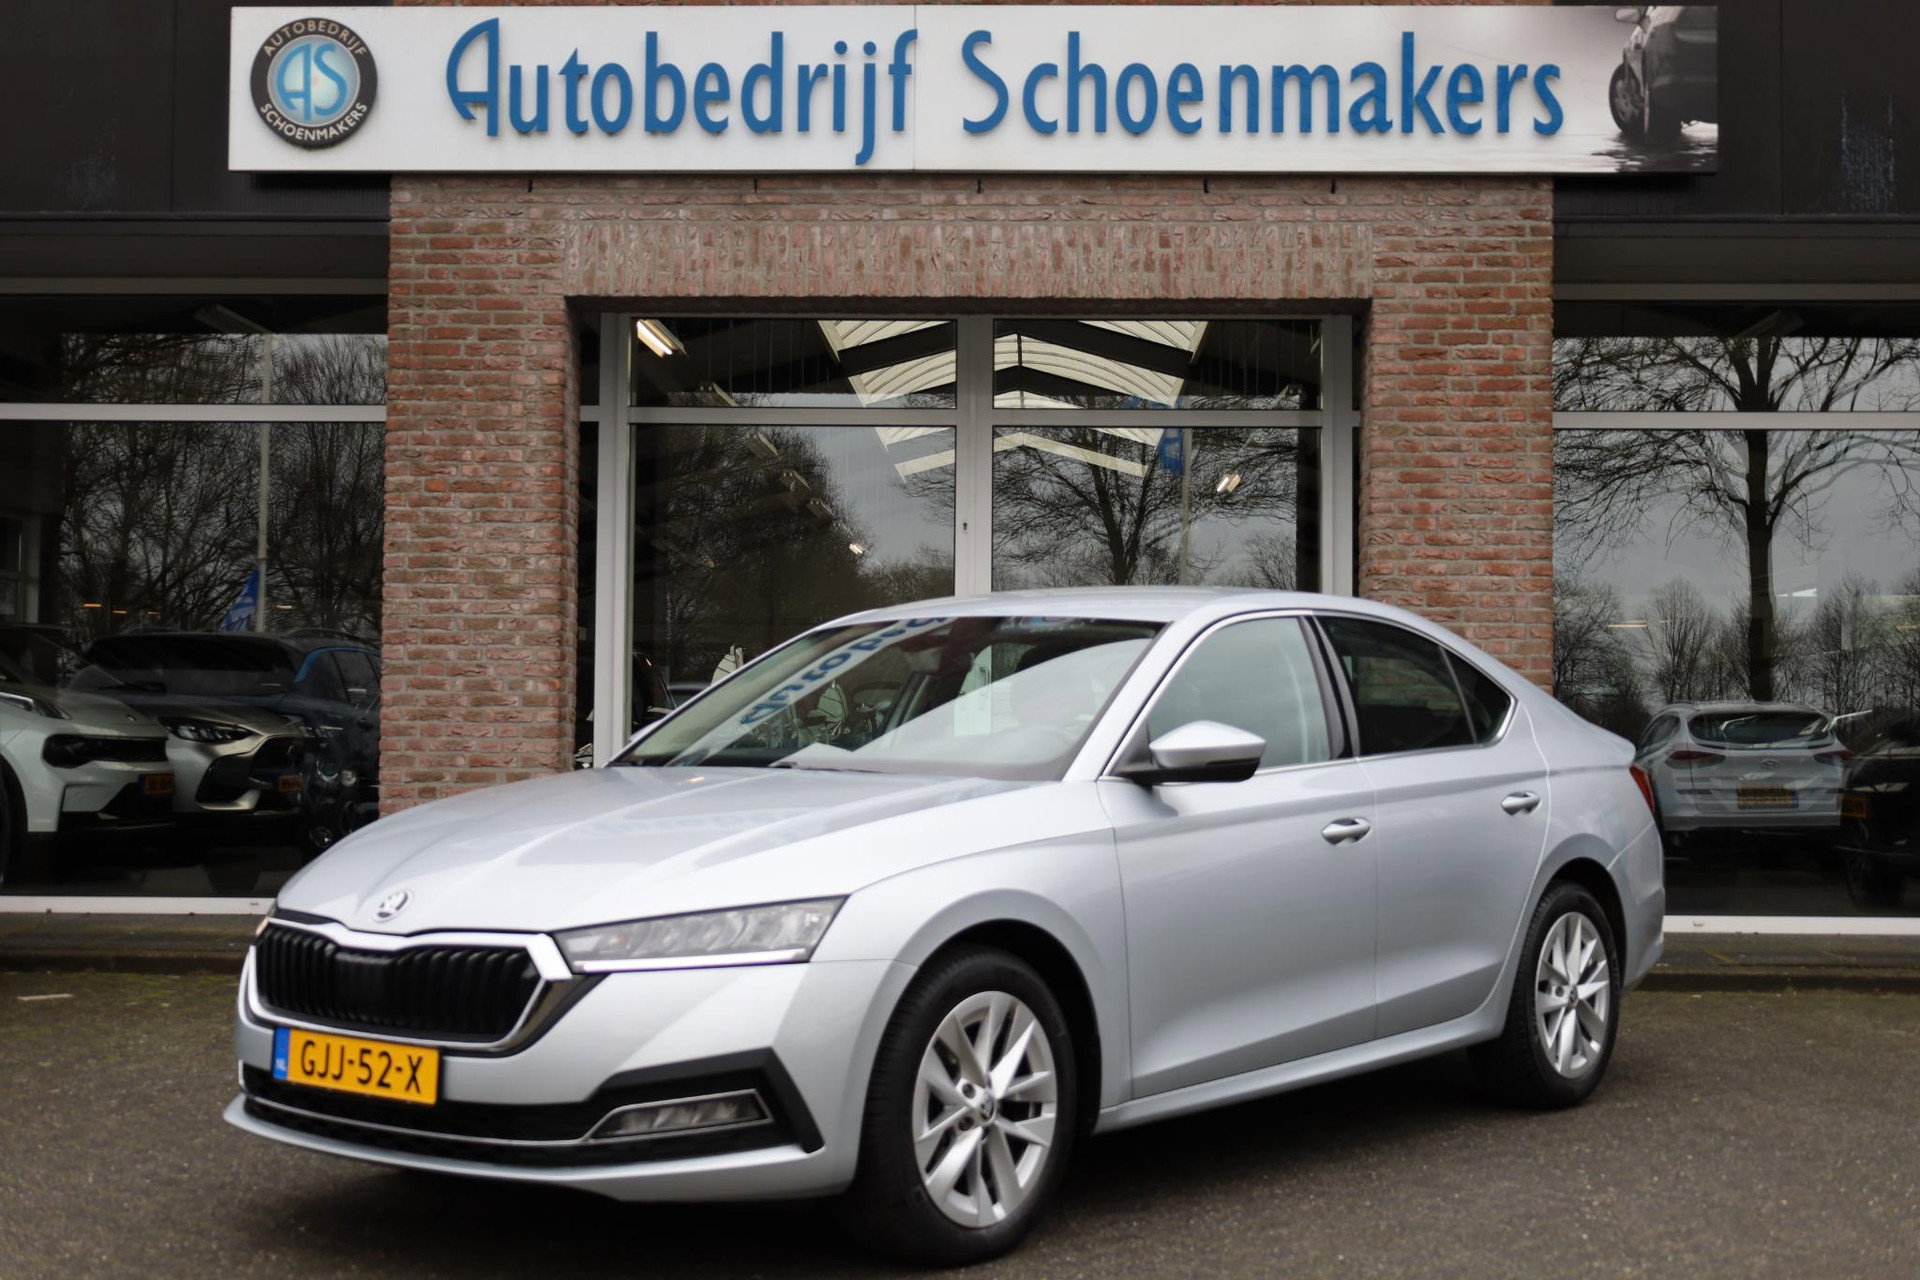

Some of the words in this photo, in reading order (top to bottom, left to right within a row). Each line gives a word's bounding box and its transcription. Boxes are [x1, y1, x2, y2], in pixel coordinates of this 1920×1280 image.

[263, 20, 367, 56] AUTOBEDRIJF
[276, 43, 347, 121] AS
[446, 17, 918, 166] Autobedrijf
[961, 30, 1564, 136] Schoenmakers
[260, 102, 368, 142] SCHOENMAKERS
[301, 1040, 423, 1094] GJJ-52-X
